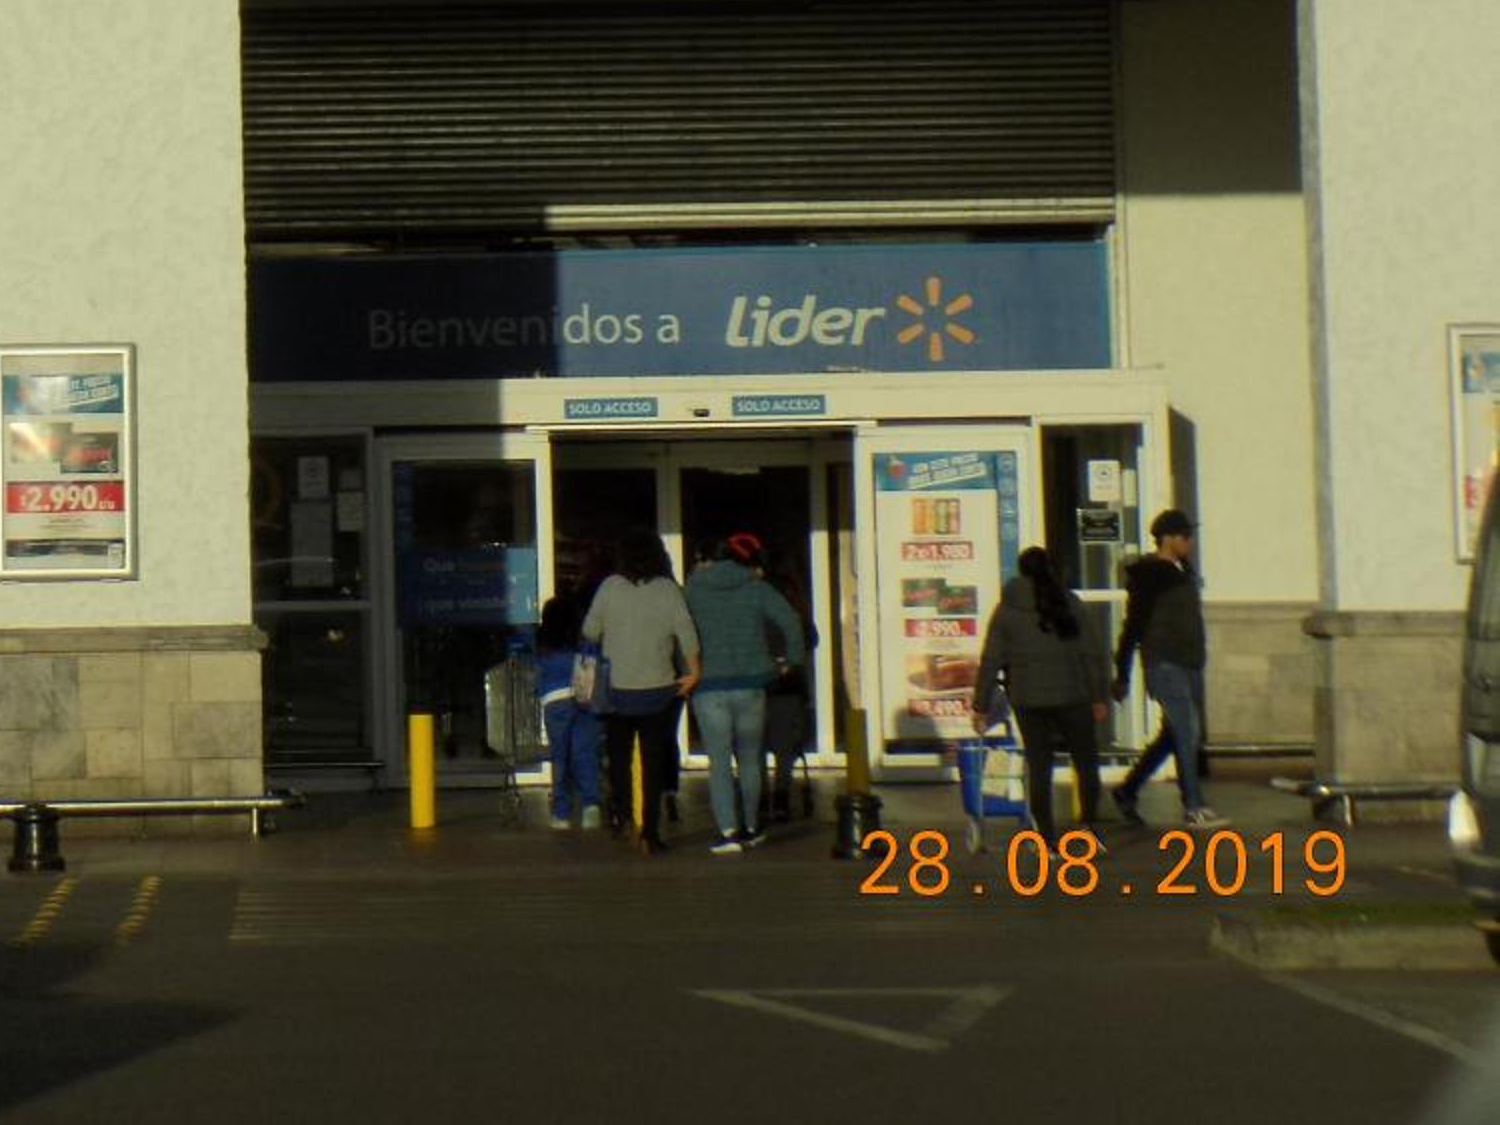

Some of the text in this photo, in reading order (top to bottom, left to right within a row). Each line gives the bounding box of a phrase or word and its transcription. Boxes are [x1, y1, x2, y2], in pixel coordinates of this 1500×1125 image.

[367, 302, 643, 349] Bienvenidos
[656, 314, 680, 344] a
[569, 400, 651, 415] SOLO ACCESO
[736, 397, 821, 412] SOLO ACCESO
